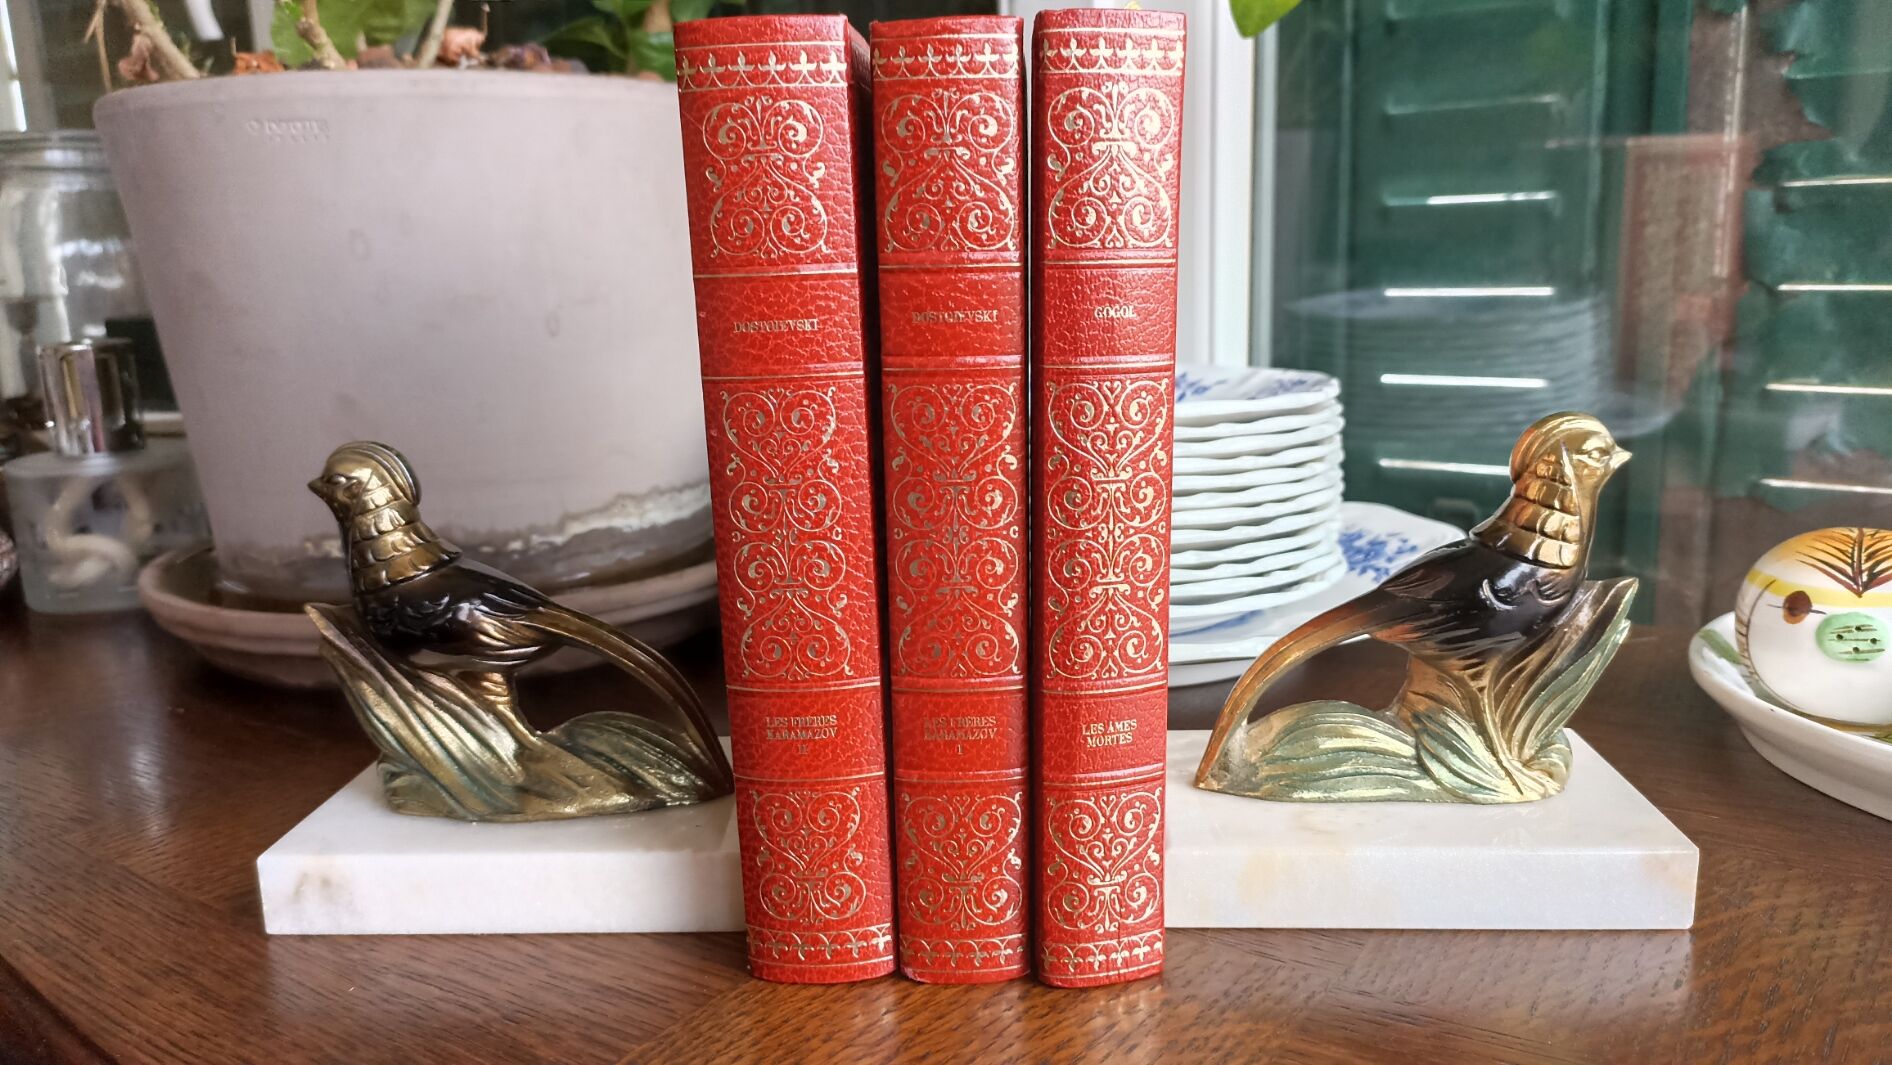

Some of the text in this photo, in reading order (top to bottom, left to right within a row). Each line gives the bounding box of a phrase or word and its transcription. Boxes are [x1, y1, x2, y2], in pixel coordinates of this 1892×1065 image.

[1094, 304, 1137, 319] GOGOL
[733, 318, 819, 334] DOSTOIEVSKI
[766, 717, 788, 728] LES
[1082, 722, 1105, 736] LES
[1087, 732, 1133, 748] MORTES
